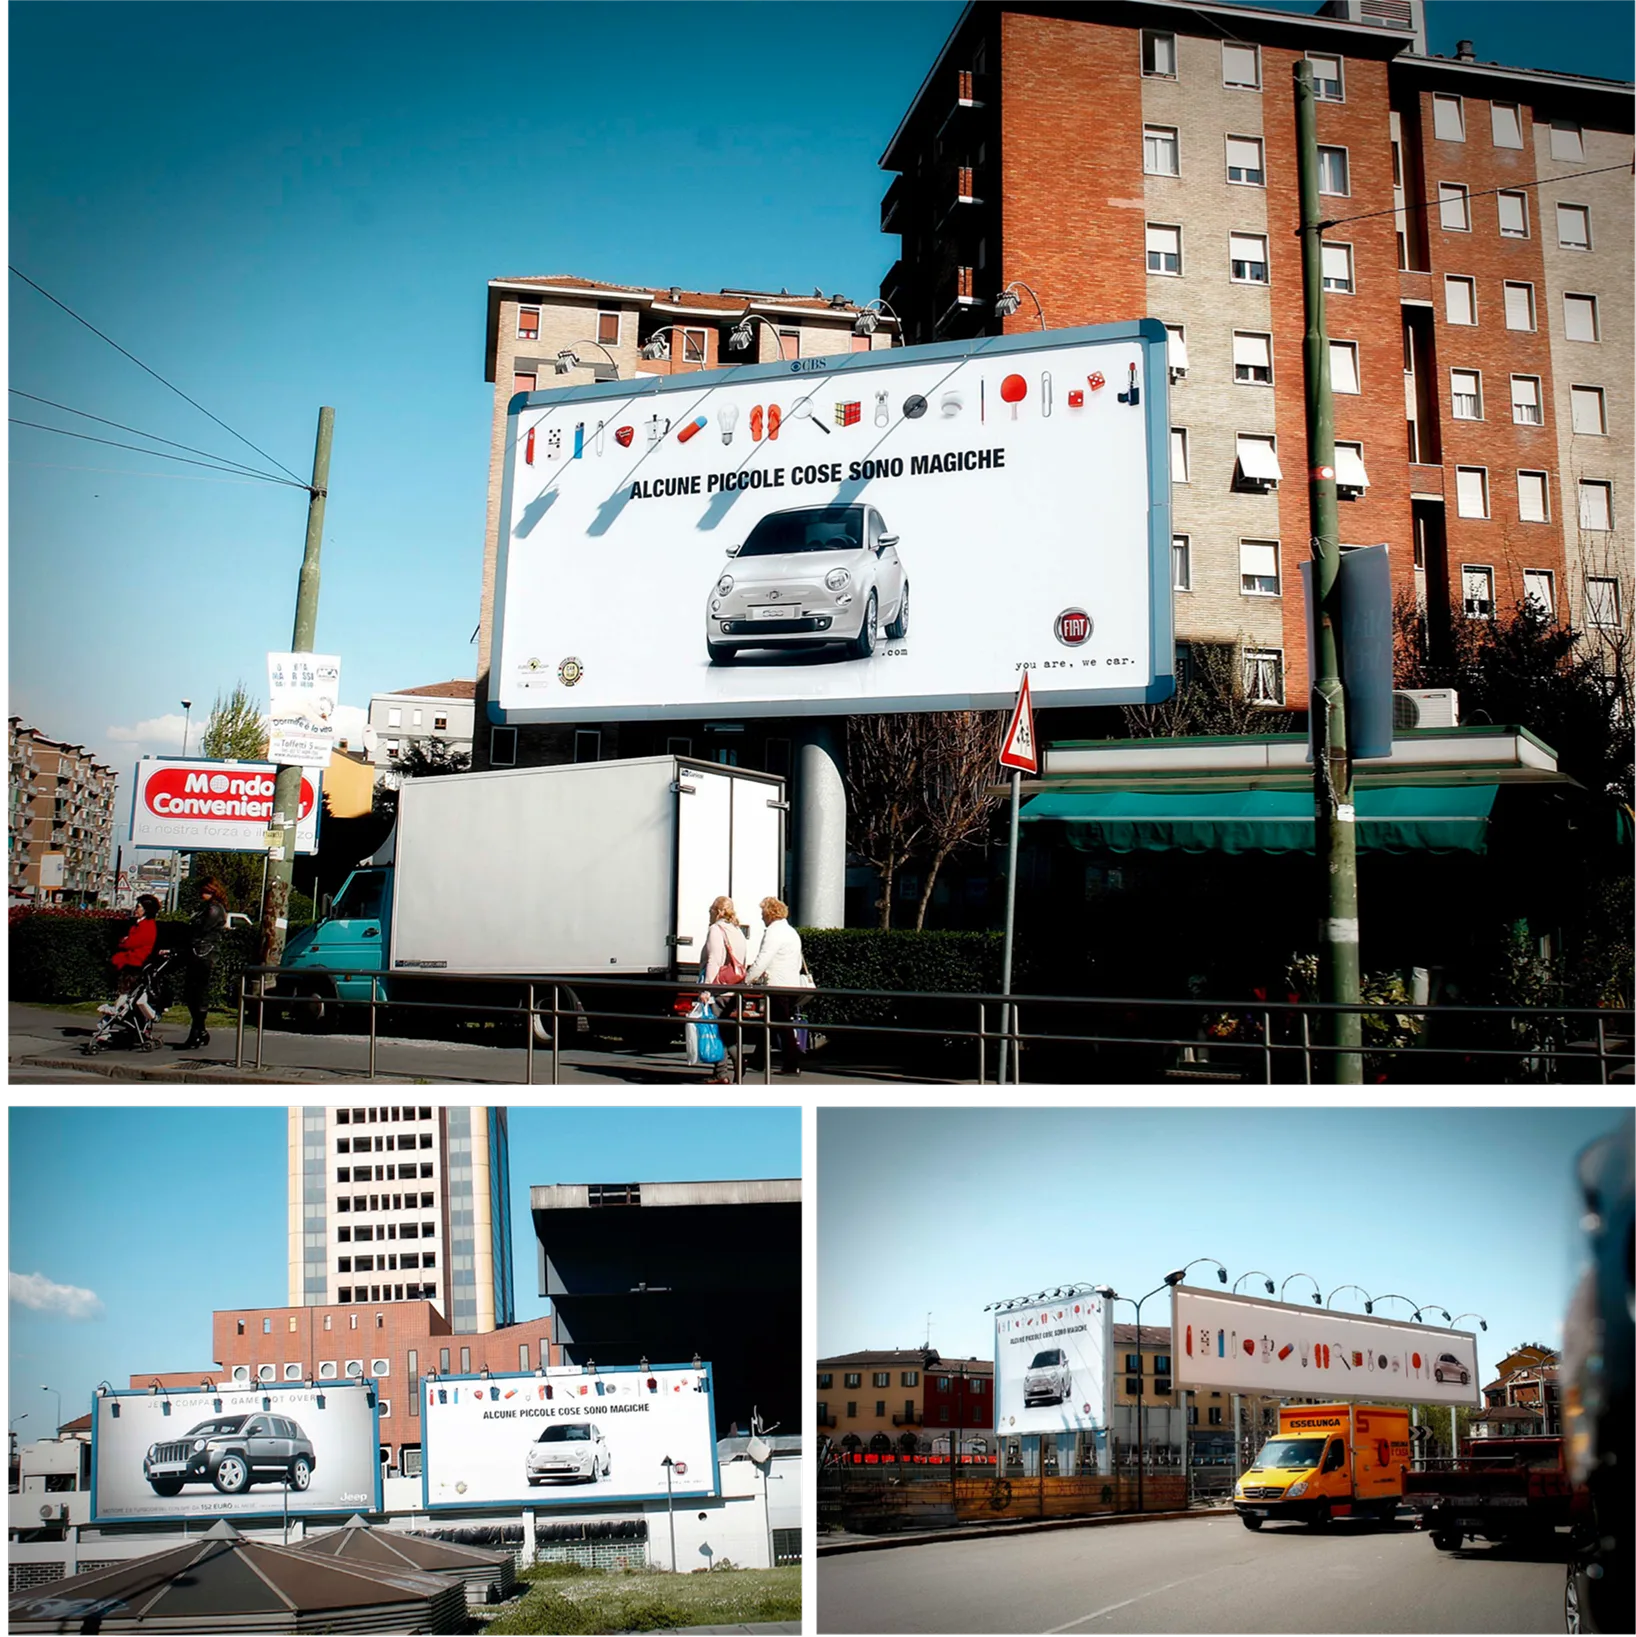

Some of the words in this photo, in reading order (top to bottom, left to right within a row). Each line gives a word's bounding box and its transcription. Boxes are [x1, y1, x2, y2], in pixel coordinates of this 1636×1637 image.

[802, 358, 827, 371] CBS
[629, 475, 701, 500] ALCUNE
[707, 468, 785, 493] PICCOLE
[791, 463, 842, 486] COSE
[848, 457, 904, 481] SONO
[910, 448, 1005, 475] MAGICHE
[1063, 619, 1085, 637] FIAT
[1015, 661, 1036, 671] you
[1043, 660, 1073, 668] are,
[1106, 657, 1135, 665] car.
[184, 773, 275, 796] Mondo
[139, 824, 149, 833] la
[155, 824, 199, 835] nostra
[204, 825, 238, 836] forza
[231, 1396, 260, 1405] GAME
[289, 1394, 316, 1402] OVER
[483, 1410, 517, 1419] ALCUNE
[519, 1408, 556, 1418] PICCOLE
[558, 1406, 581, 1416] COSE
[583, 1405, 608, 1415] SONO
[610, 1403, 650, 1413] MAGICHE
[1290, 1418, 1341, 1428] ESSELUNGA
[340, 1492, 367, 1503] Jeep
[213, 1502, 232, 1510] EURO
